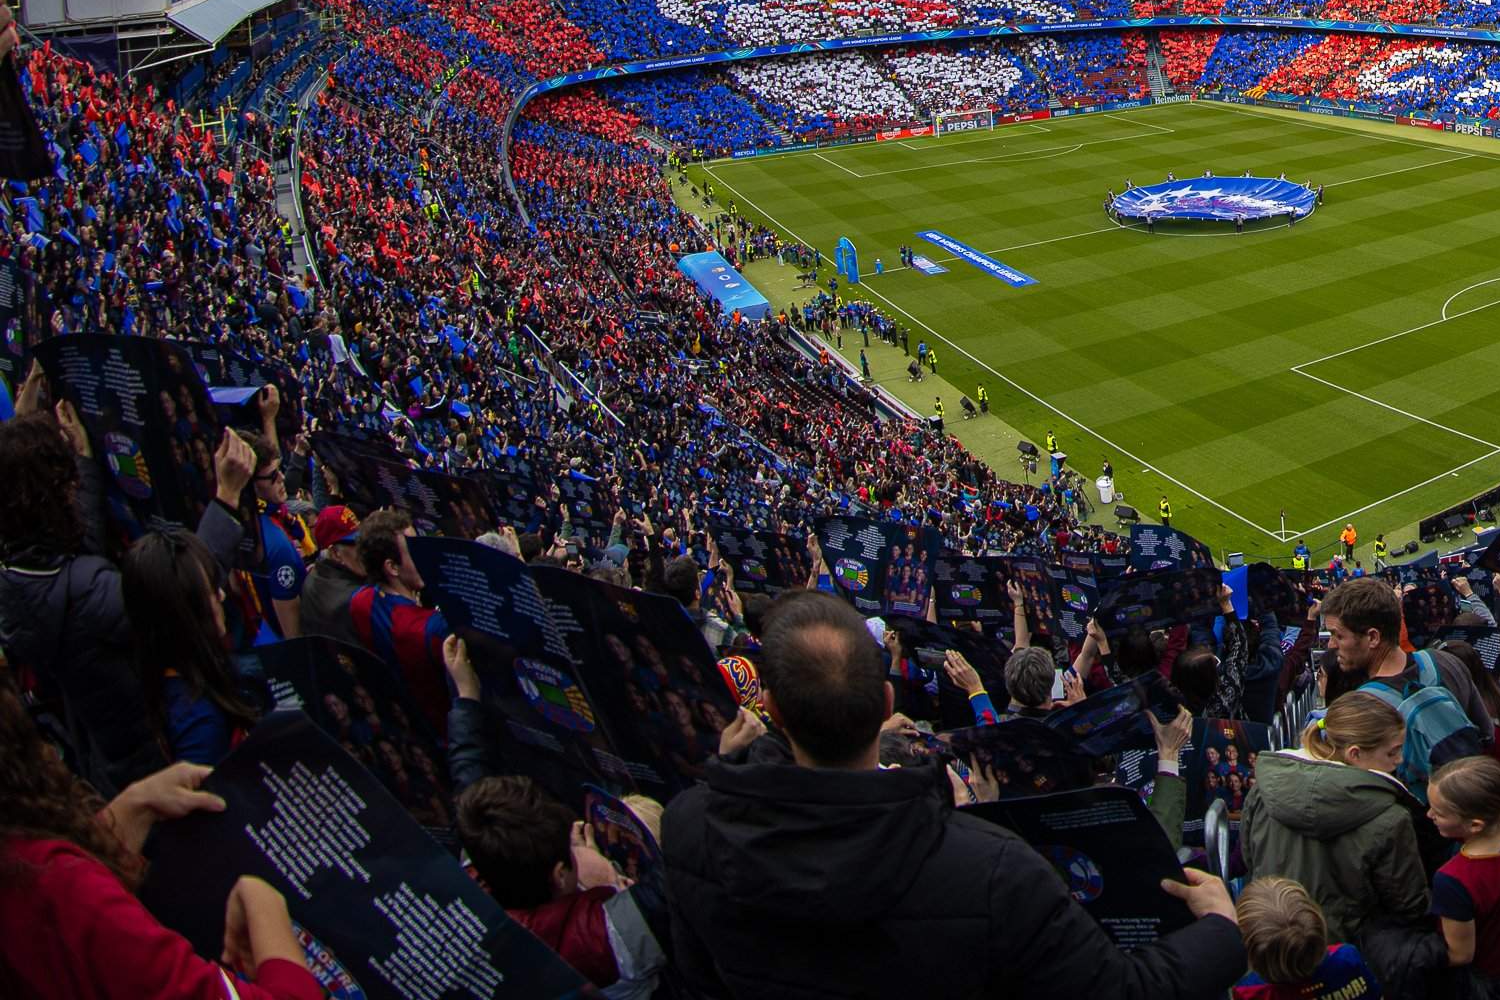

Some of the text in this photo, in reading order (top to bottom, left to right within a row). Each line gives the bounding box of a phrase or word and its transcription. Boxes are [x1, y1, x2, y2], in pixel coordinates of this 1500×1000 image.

[1154, 94, 1190, 105] Heineken
[947, 120, 978, 132] PEPSI
[1455, 123, 1483, 137] PEPSI
[308, 941, 359, 994] NOSTRE
